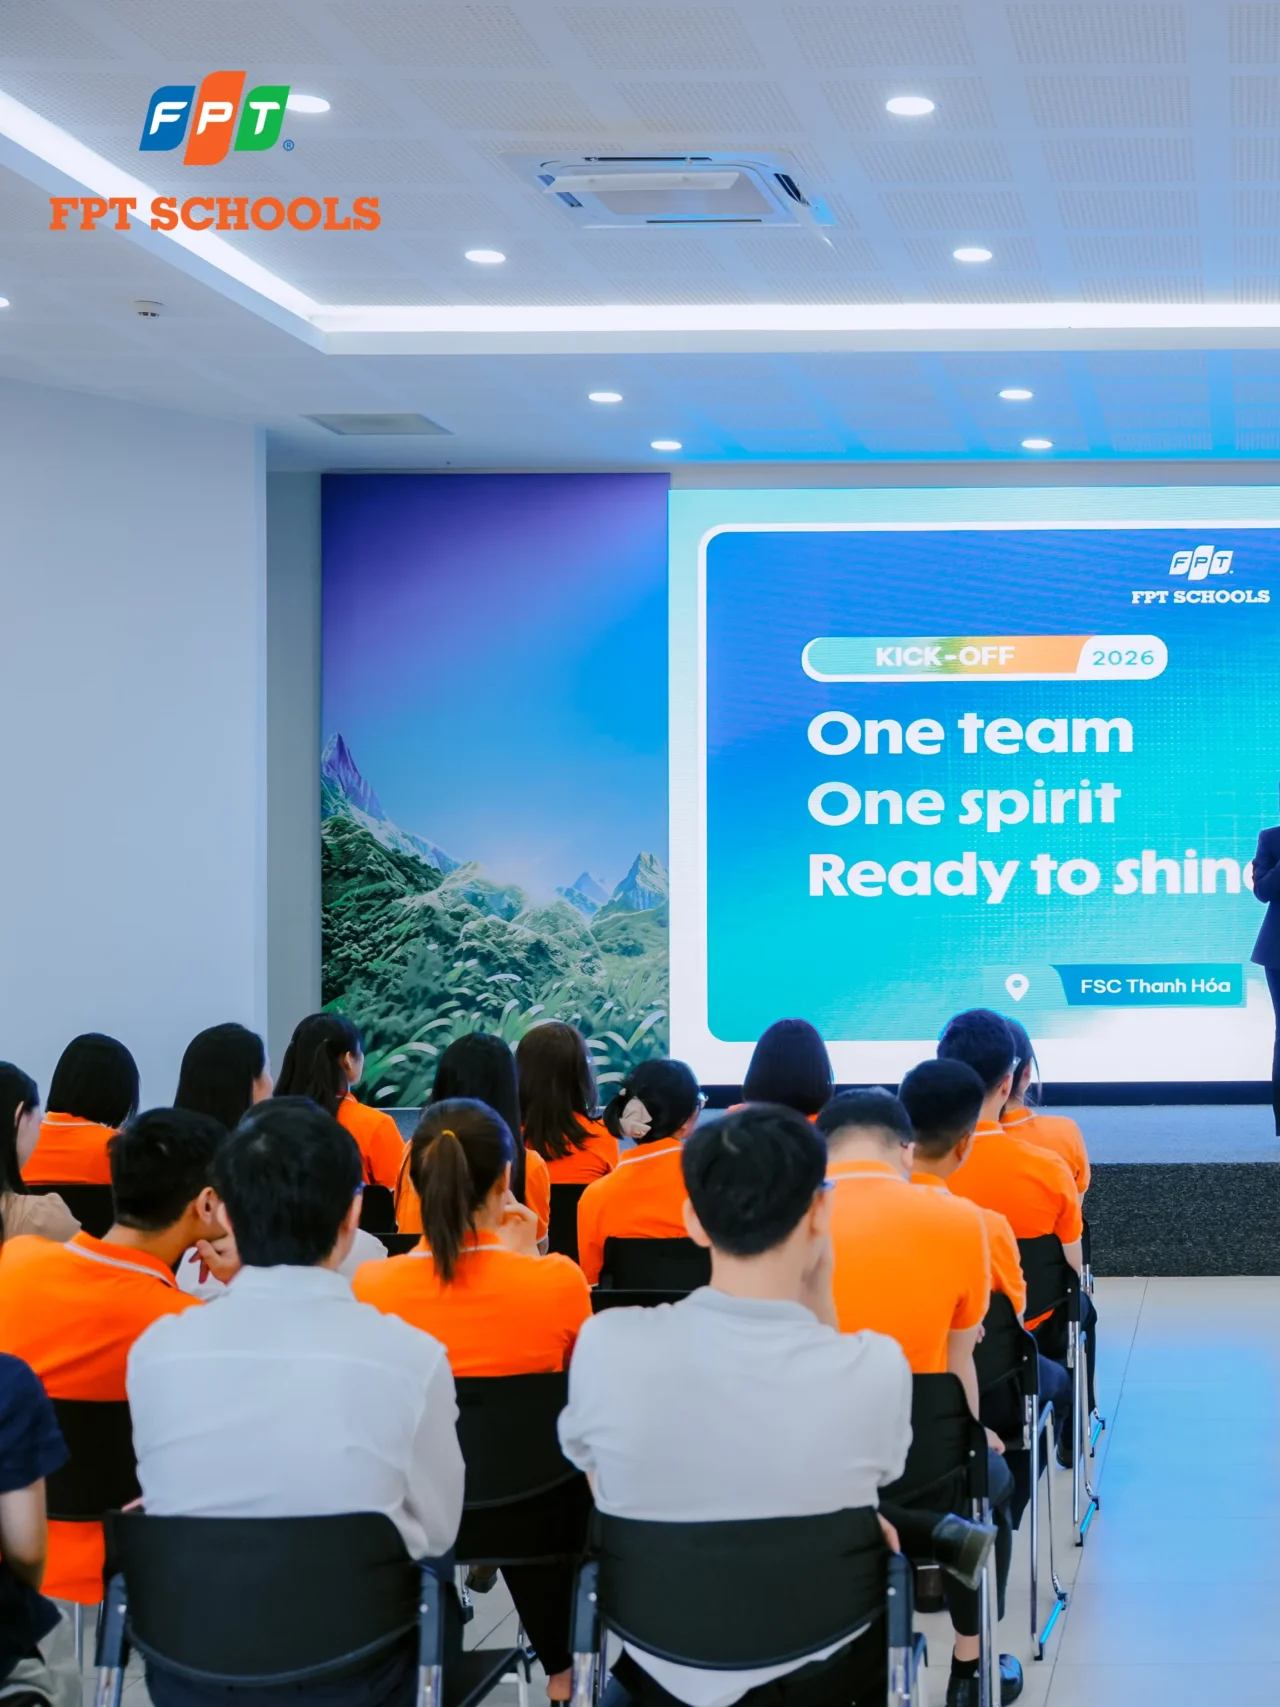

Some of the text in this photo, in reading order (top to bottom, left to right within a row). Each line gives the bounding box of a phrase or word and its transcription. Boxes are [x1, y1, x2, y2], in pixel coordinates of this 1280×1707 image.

[1131, 589, 1270, 604] FPT SCHOOLS
[875, 645, 1155, 668] KICK-OFF 2026
[807, 710, 1134, 756] One team
[807, 779, 1121, 833] One spirit
[808, 848, 1255, 904] Ready to shin
[1080, 977, 1231, 994] FSC Thanh Hóa
